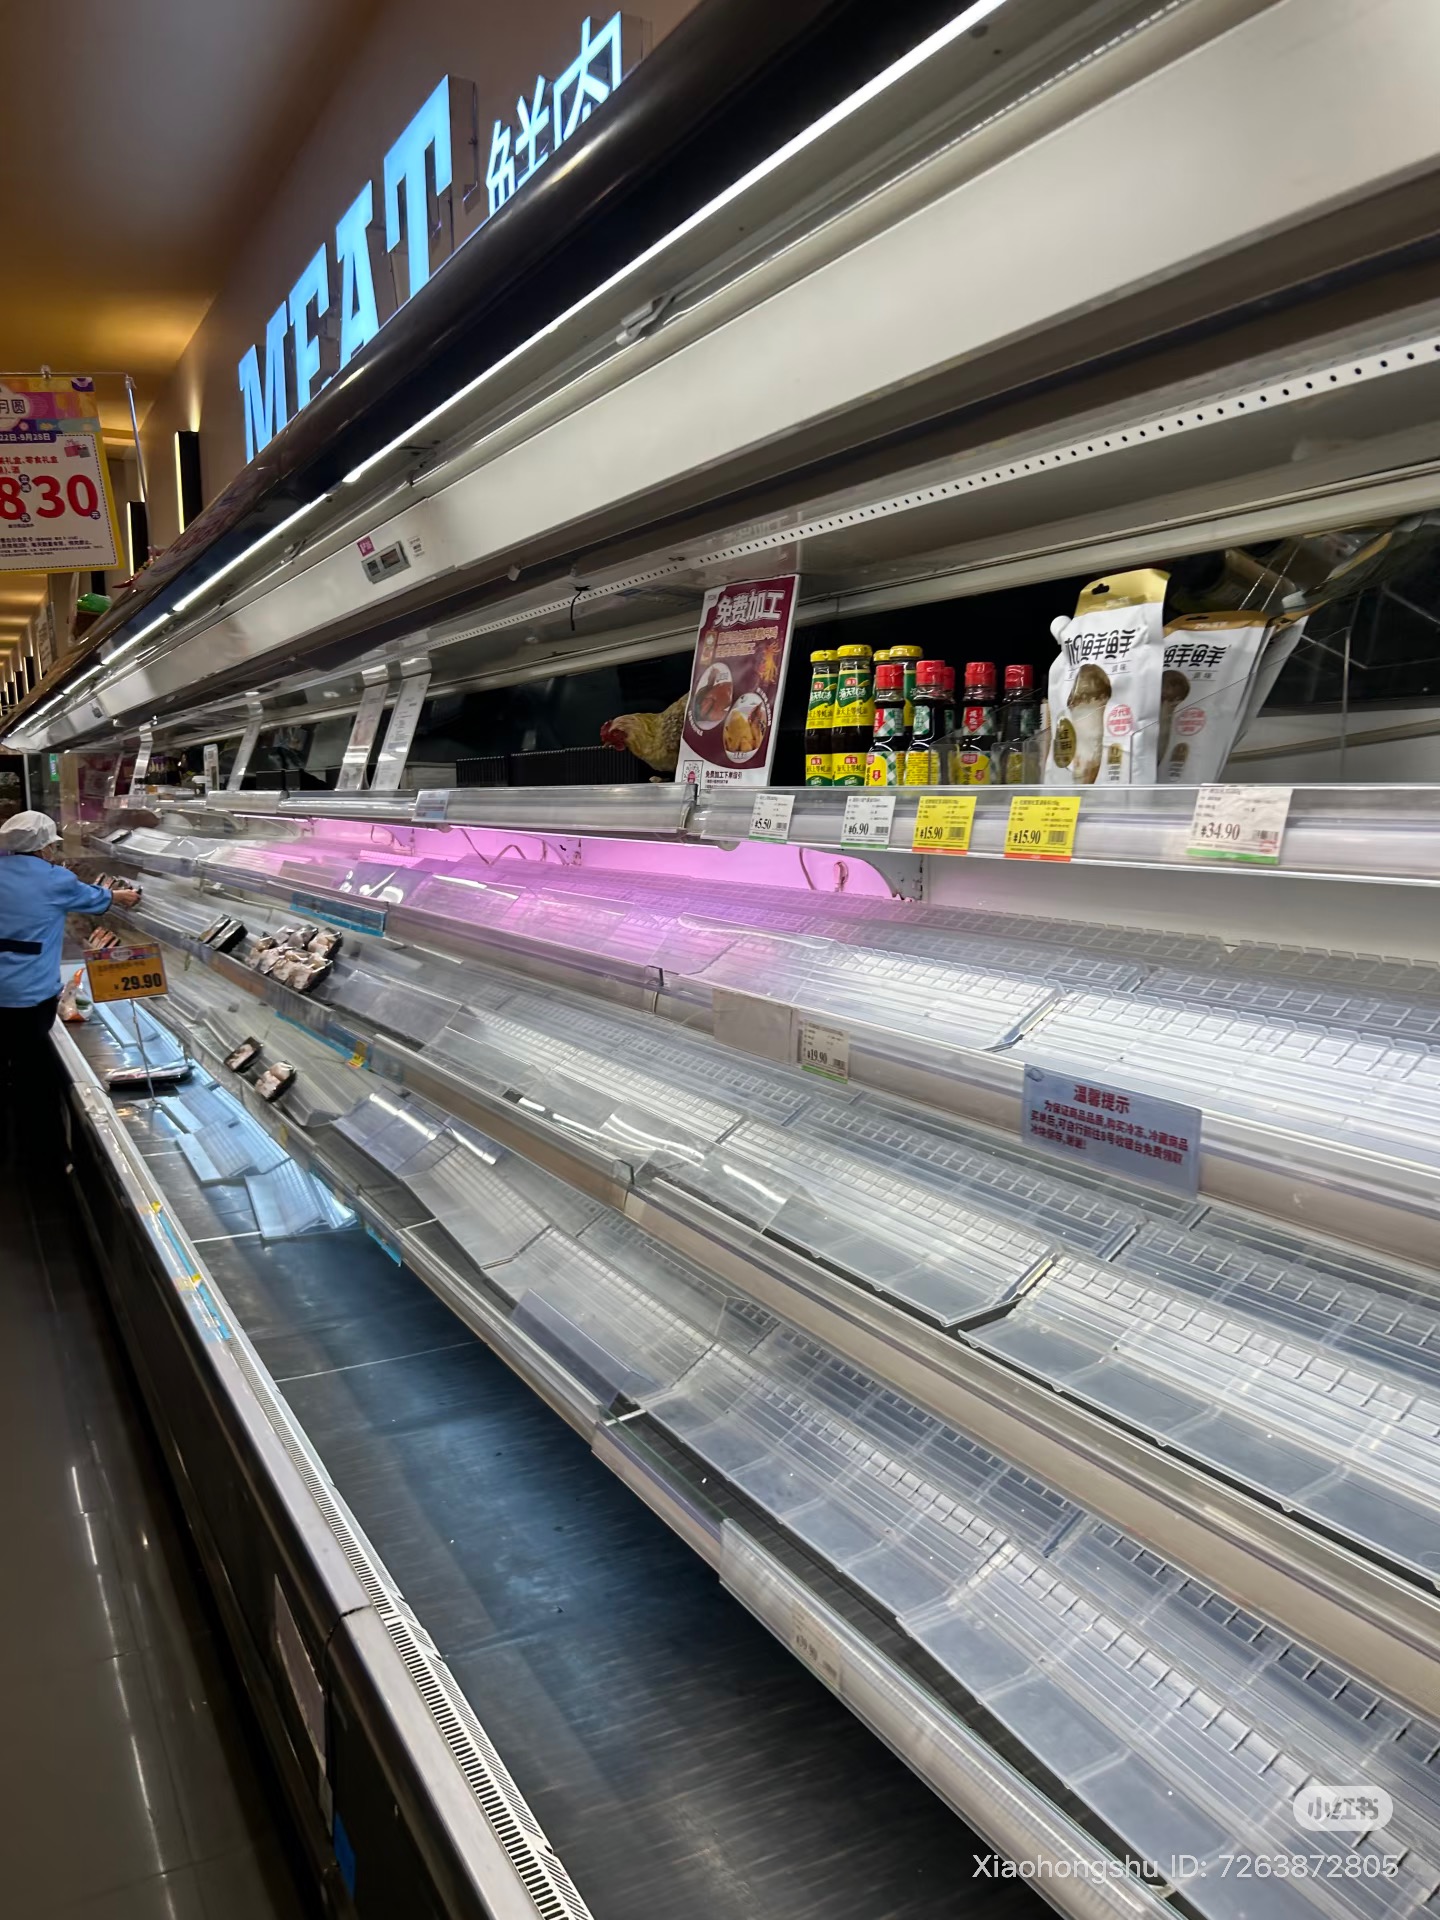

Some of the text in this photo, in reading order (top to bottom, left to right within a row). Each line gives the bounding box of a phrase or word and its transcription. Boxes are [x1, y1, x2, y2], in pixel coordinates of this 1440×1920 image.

[485, 10, 622, 218] 鲜肉
[237, 73, 453, 465] MEAT
[32, 474, 99, 518] 30
[714, 590, 785, 628] 免费加工
[919, 826, 943, 840] ¥15.90
[1013, 829, 1041, 845] ¥15.90
[1200, 821, 1241, 841] ¥34.90
[121, 972, 162, 991] 29.90
[1073, 1084, 1131, 1115] 温馨提示
